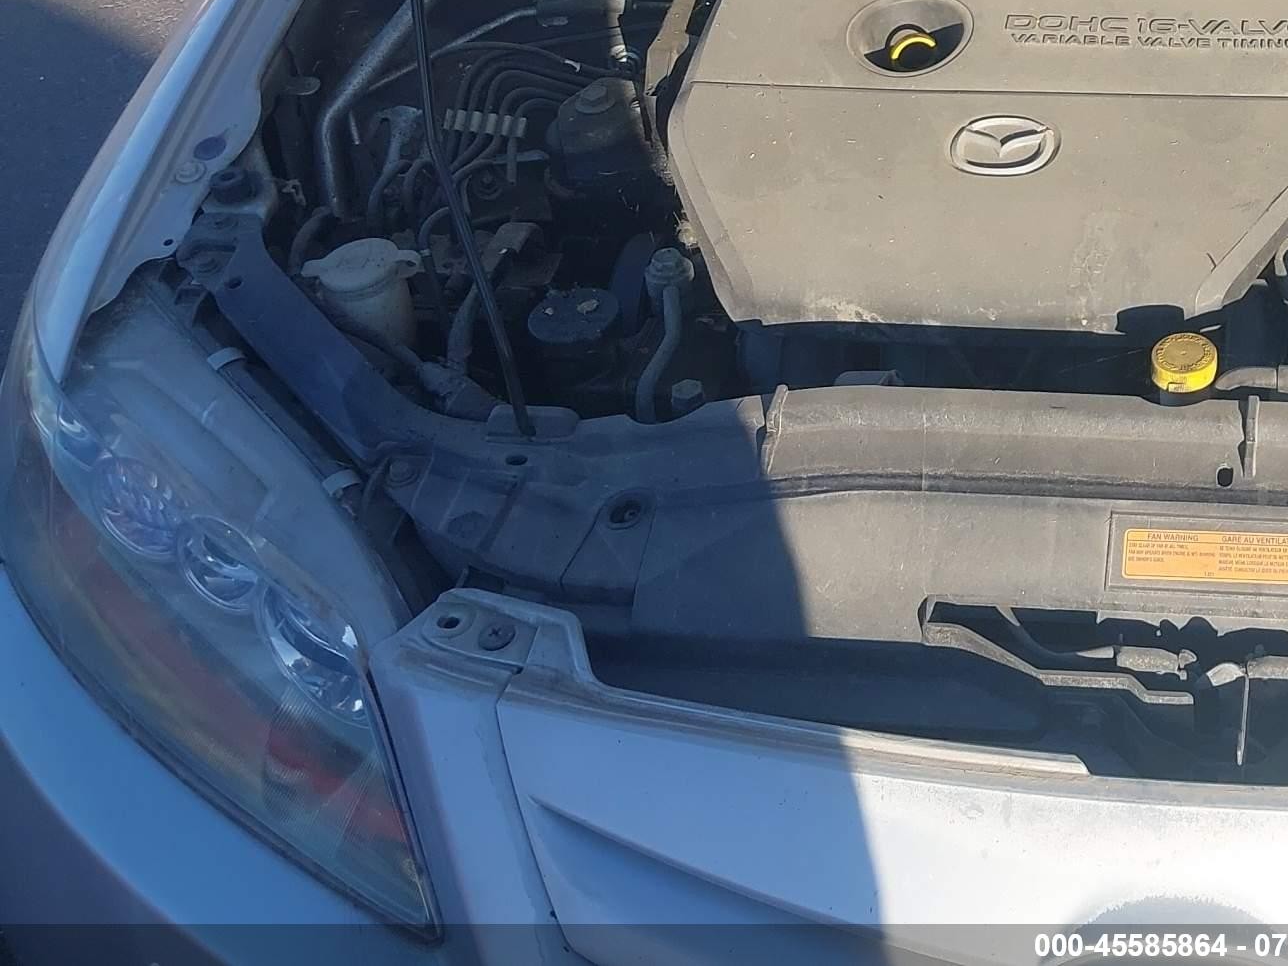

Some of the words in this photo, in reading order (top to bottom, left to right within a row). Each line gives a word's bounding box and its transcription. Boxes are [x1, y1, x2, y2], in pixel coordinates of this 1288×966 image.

[1004, 13, 1129, 34] DOHC
[1010, 33, 1129, 46] VARIABLE
[1138, 36, 1211, 49] VALVE
[1147, 533, 1162, 541] FAN
[1163, 534, 1199, 542] WARNING
